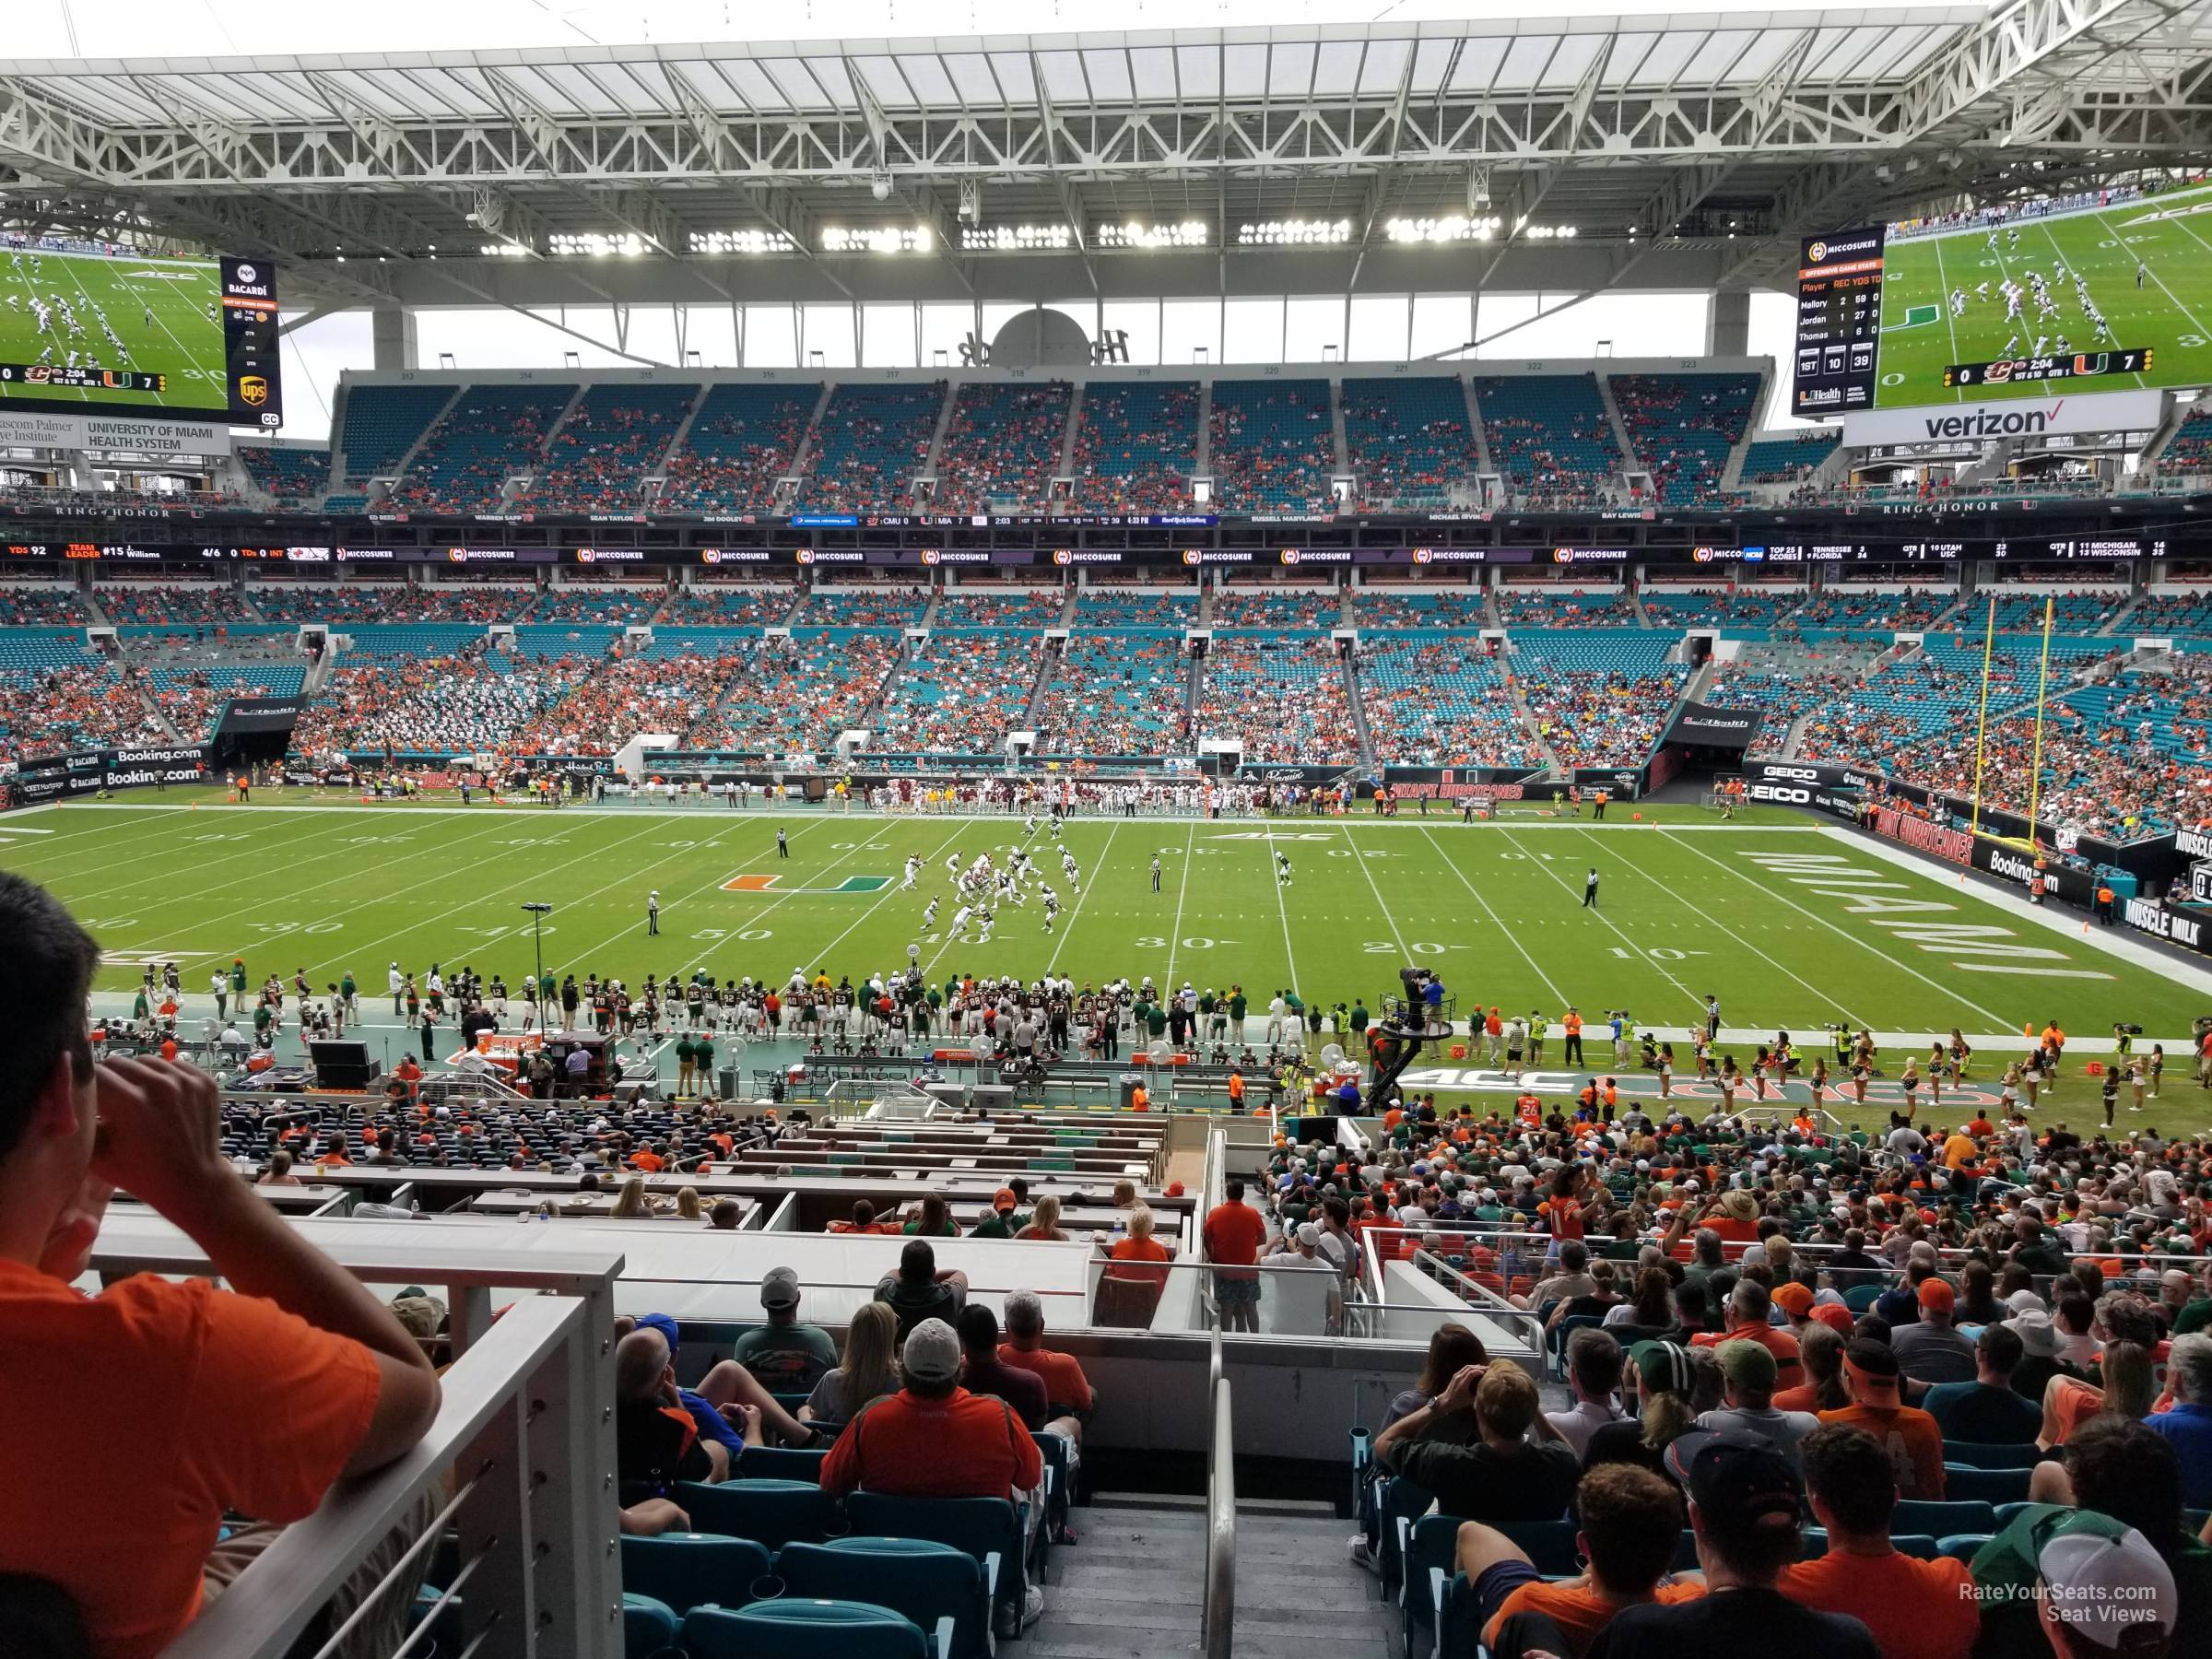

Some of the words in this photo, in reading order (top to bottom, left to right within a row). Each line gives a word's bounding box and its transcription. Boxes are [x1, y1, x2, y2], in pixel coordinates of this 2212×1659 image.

[1828, 240, 1877, 254] MICCOSUKEE
[1806, 266, 1839, 277] OFFENSIVE
[1802, 283, 1827, 293] Player
[1833, 279, 1850, 288] REC
[1853, 276, 1869, 286] YDS
[1871, 275, 1882, 283] TD
[229, 284, 267, 296] BACARDÍ
[1800, 300, 1828, 310] Mallory
[1840, 297, 1846, 306] 2
[1873, 292, 1879, 301] 0
[1800, 316, 1827, 325] Jordan
[1854, 311, 1865, 320] 27
[1872, 310, 1878, 318] 0
[1799, 332, 1829, 341] Thomas
[1871, 325, 1877, 334] 0
[1527, 362, 1542, 371] 322
[1680, 360, 1697, 369] 323
[1801, 360, 1817, 371] 1ST
[1829, 358, 1841, 370] 10
[1853, 356, 1869, 366] 39
[2030, 359, 2053, 370] 2:04
[2124, 356, 2135, 370] 7
[2, 369, 11, 379] 0
[66, 369, 86, 378] 2:04
[1011, 369, 1025, 377] 318
[1136, 369, 1150, 377] 319
[1959, 370, 1970, 383] 0
[2033, 371, 2041, 379] 10
[2048, 369, 2063, 378] QTR
[144, 378, 151, 388] 7
[242, 383, 265, 398] ups
[263, 415, 278, 424] CC
[1925, 408, 2045, 439] verizon
[37, 421, 73, 432] Palmer
[88, 422, 155, 435] UNIVERSITY
[159, 426, 173, 436] OF
[176, 427, 213, 439] MIAMI
[15, 431, 57, 442] Institute
[89, 436, 133, 448] HEALTH
[136, 438, 181, 450] SYSTEM
[55, 507, 97, 515] RING
[112, 508, 170, 518] HONOR
[1883, 503, 1923, 513] RING
[1939, 502, 1998, 512] HONOR
[31, 547, 46, 555] 92
[2090, 541, 2137, 550] MICHIGAN
[103, 547, 124, 556] #15
[202, 548, 221, 558] 4/6
[230, 548, 238, 558] 0
[259, 548, 266, 558] 0
[269, 549, 284, 558] INT
[126, 550, 160, 559] Williams
[347, 550, 393, 559] MICCOSUKEE
[596, 551, 643, 559] MICCOSUKEE
[722, 552, 770, 560] MICCOSUKEE
[940, 553, 989, 561] MICCOSUKEE
[1072, 553, 1122, 561] MICCOSUKEE
[1300, 552, 1351, 560] MICCOSUKEE
[1574, 550, 1628, 559] MICCOSUKEE
[2090, 548, 2141, 557] WISCONSIN
[2152, 547, 2165, 556] 35
[75, 754, 99, 767] BACARDÍ
[118, 748, 202, 762] Booking.com
[107, 769, 200, 784] Bookin.com
[1763, 766, 1818, 780] GEICO
[78, 777, 101, 789] BACARDÍ
[1439, 782, 1524, 800] HURRICANES
[1899, 814, 1975, 866] HURRICANES
[1735, 851, 2120, 980] MIAMI
[258, 921, 344, 934] 30
[2125, 899, 2170, 936] MUSCLE
[2171, 916, 2202, 946] MILK
[470, 926, 558, 937] 40
[690, 928, 772, 940] 50
[1135, 935, 1215, 949] 30
[1362, 941, 1445, 955] 20
[1606, 947, 1689, 960] 10
[492, 988, 501, 996] 12
[1146, 991, 1155, 1000] 15
[595, 996, 606, 1006] 70
[724, 994, 735, 1003] 92
[969, 996, 981, 1006] 88
[1029, 997, 1040, 1006] 99
[1120, 994, 1131, 1002] 94
[918, 1006, 928, 1015] 61
[1053, 1005, 1065, 1014] 77
[1218, 1005, 1227, 1013] 21
[636, 1018, 648, 1026] 22
[890, 1016, 902, 1026] 49
[1077, 1014, 1088, 1023] 35
[143, 1030, 155, 1040] 27
[261, 1033, 269, 1042] 5
[994, 1040, 1001, 1050] 9
[1004, 1062, 1016, 1073] 44
[1395, 1069, 1587, 1092] ACC
[1523, 1104, 1538, 1116] 26
